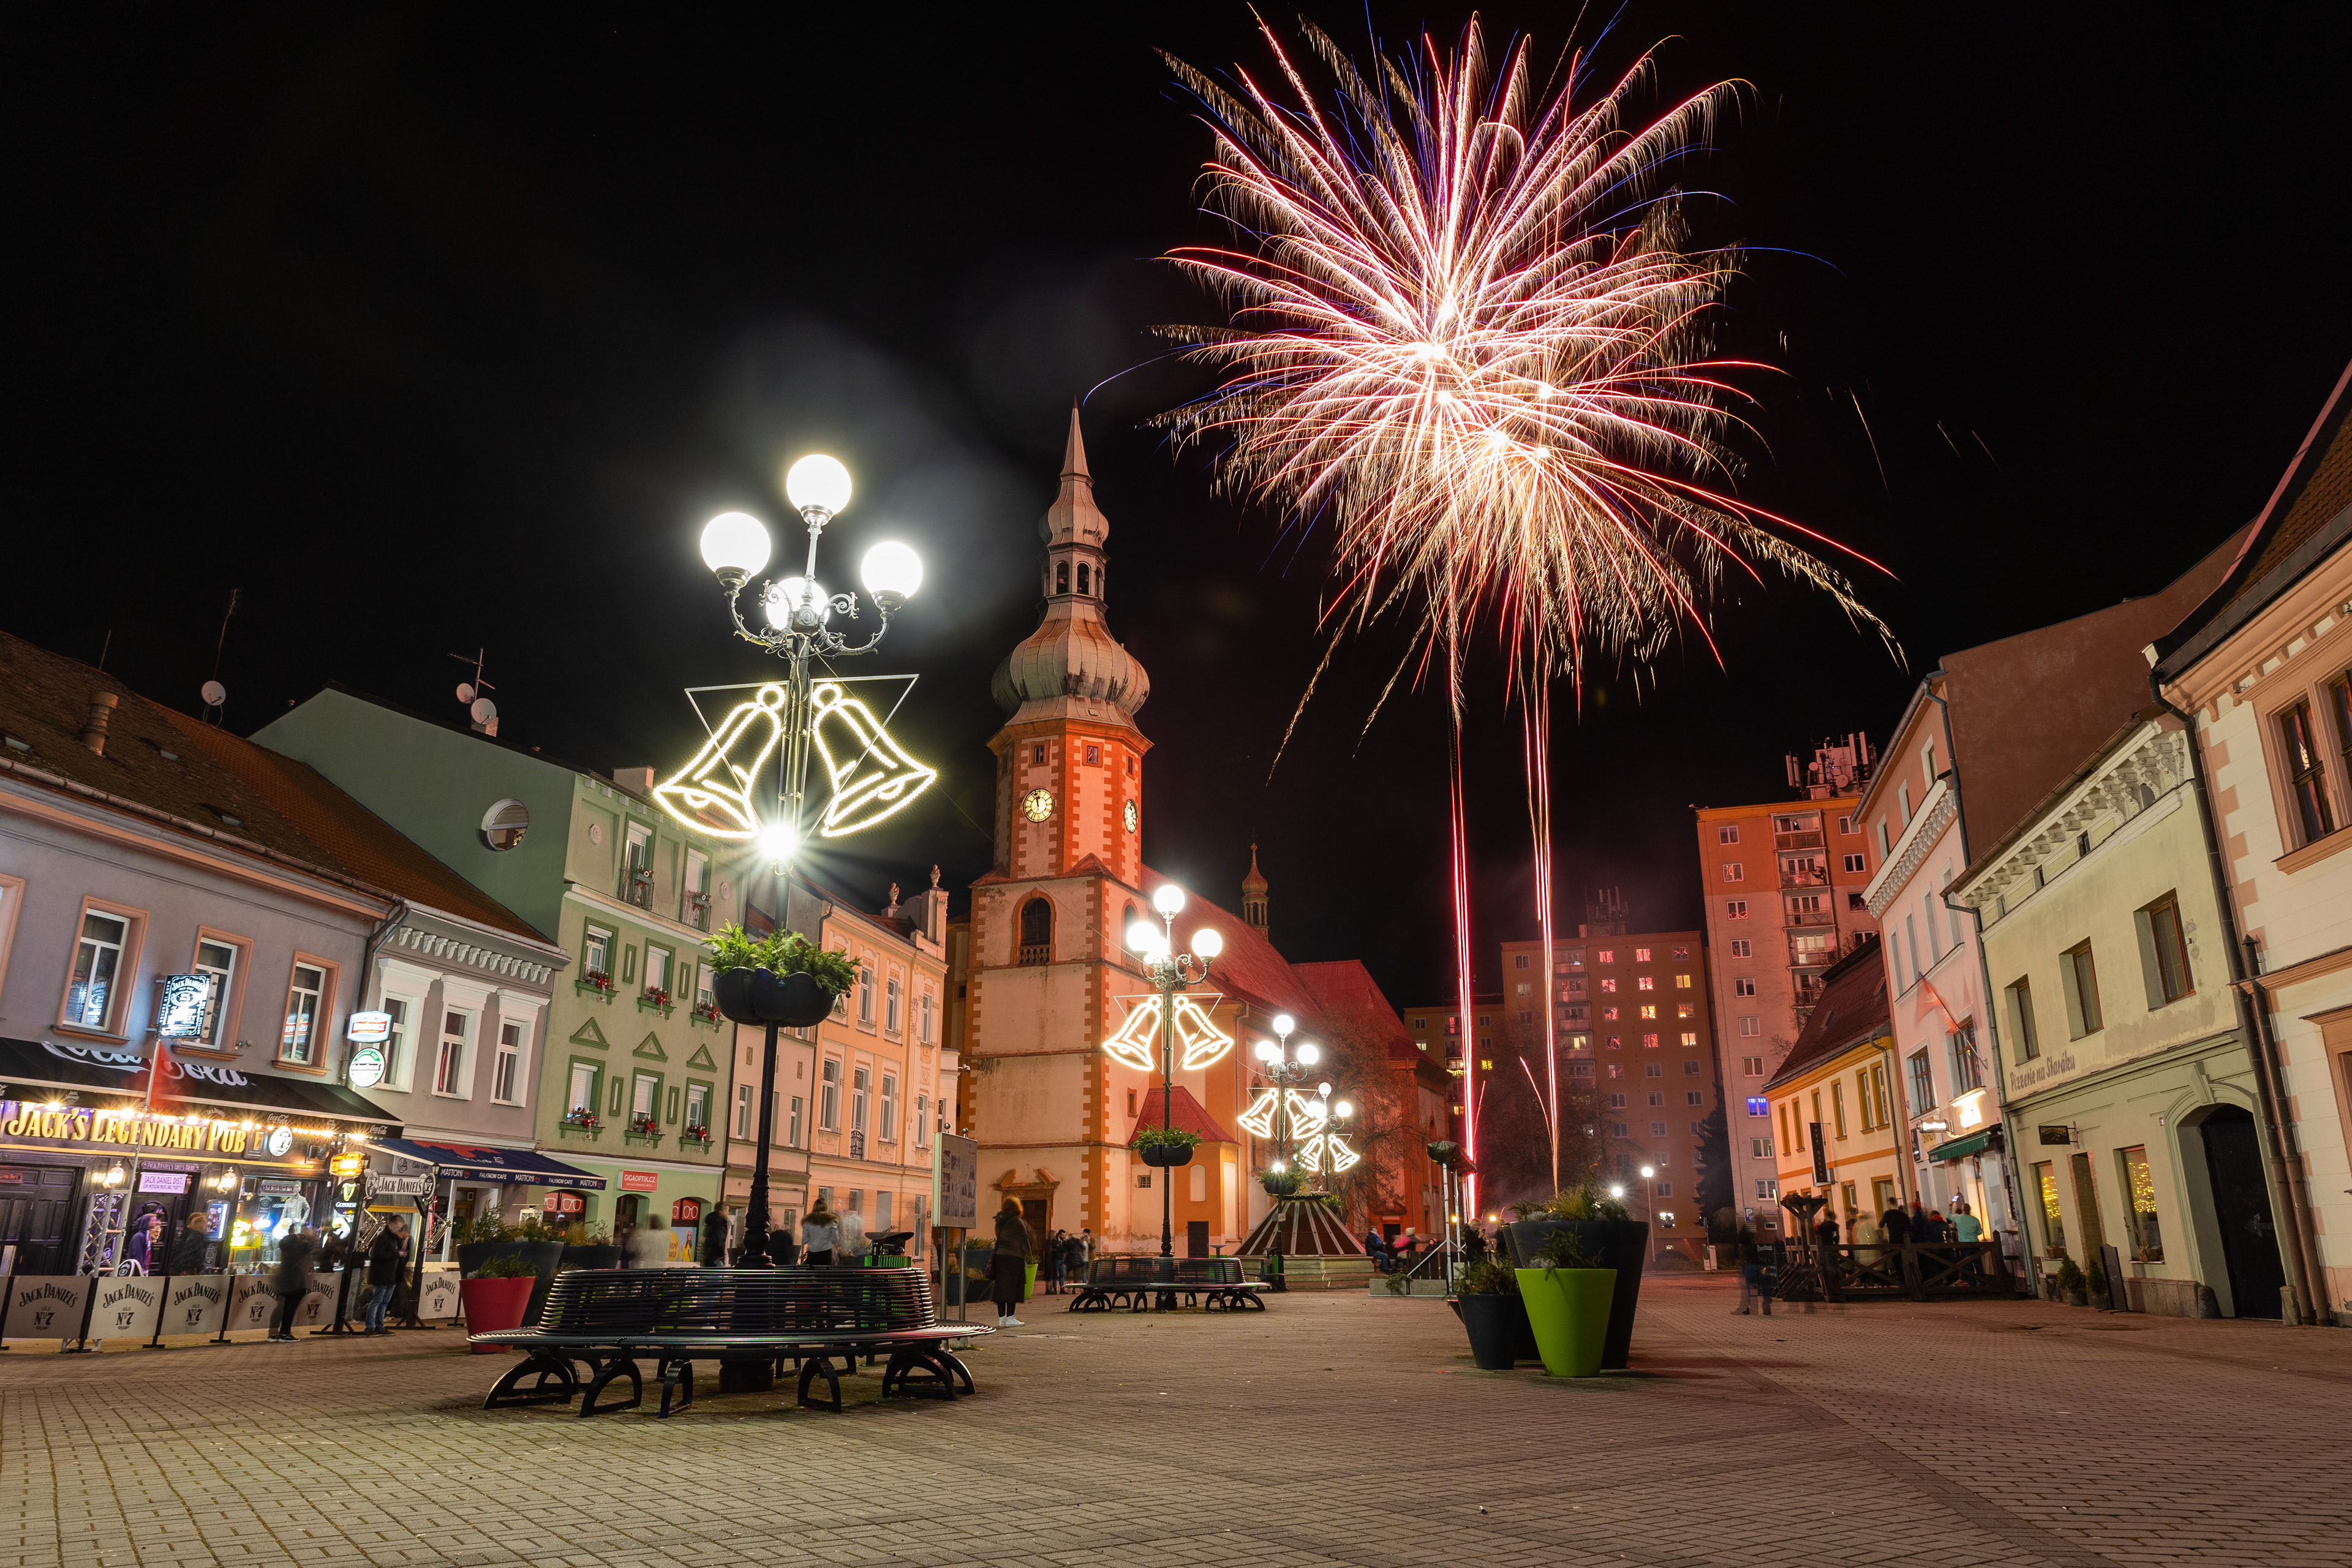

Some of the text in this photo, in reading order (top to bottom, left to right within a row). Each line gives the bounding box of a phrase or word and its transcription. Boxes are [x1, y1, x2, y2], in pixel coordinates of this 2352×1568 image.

[2010, 1049, 2075, 1092] Pizzerie na Staráku
[9, 1102, 89, 1140] JACK'S
[90, 1110, 208, 1150] LEGENDARY
[205, 1122, 247, 1153] PUB
[144, 1175, 156, 1184] JACK
[157, 1176, 172, 1185] DANIEL
[378, 1178, 423, 1193] JACK DANIEL'S
[624, 1174, 656, 1183] GIGAOPTIK.CZ
[19, 1283, 78, 1308] JACK DANIEL'S
[174, 1282, 221, 1306] JACK DANIEL'S
[238, 1285, 257, 1303] JACK
[312, 1280, 334, 1300] DANIEL'S
[425, 1276, 456, 1296] JACK DANIEL'S
[103, 1284, 155, 1309] JACK DANIEL'S
